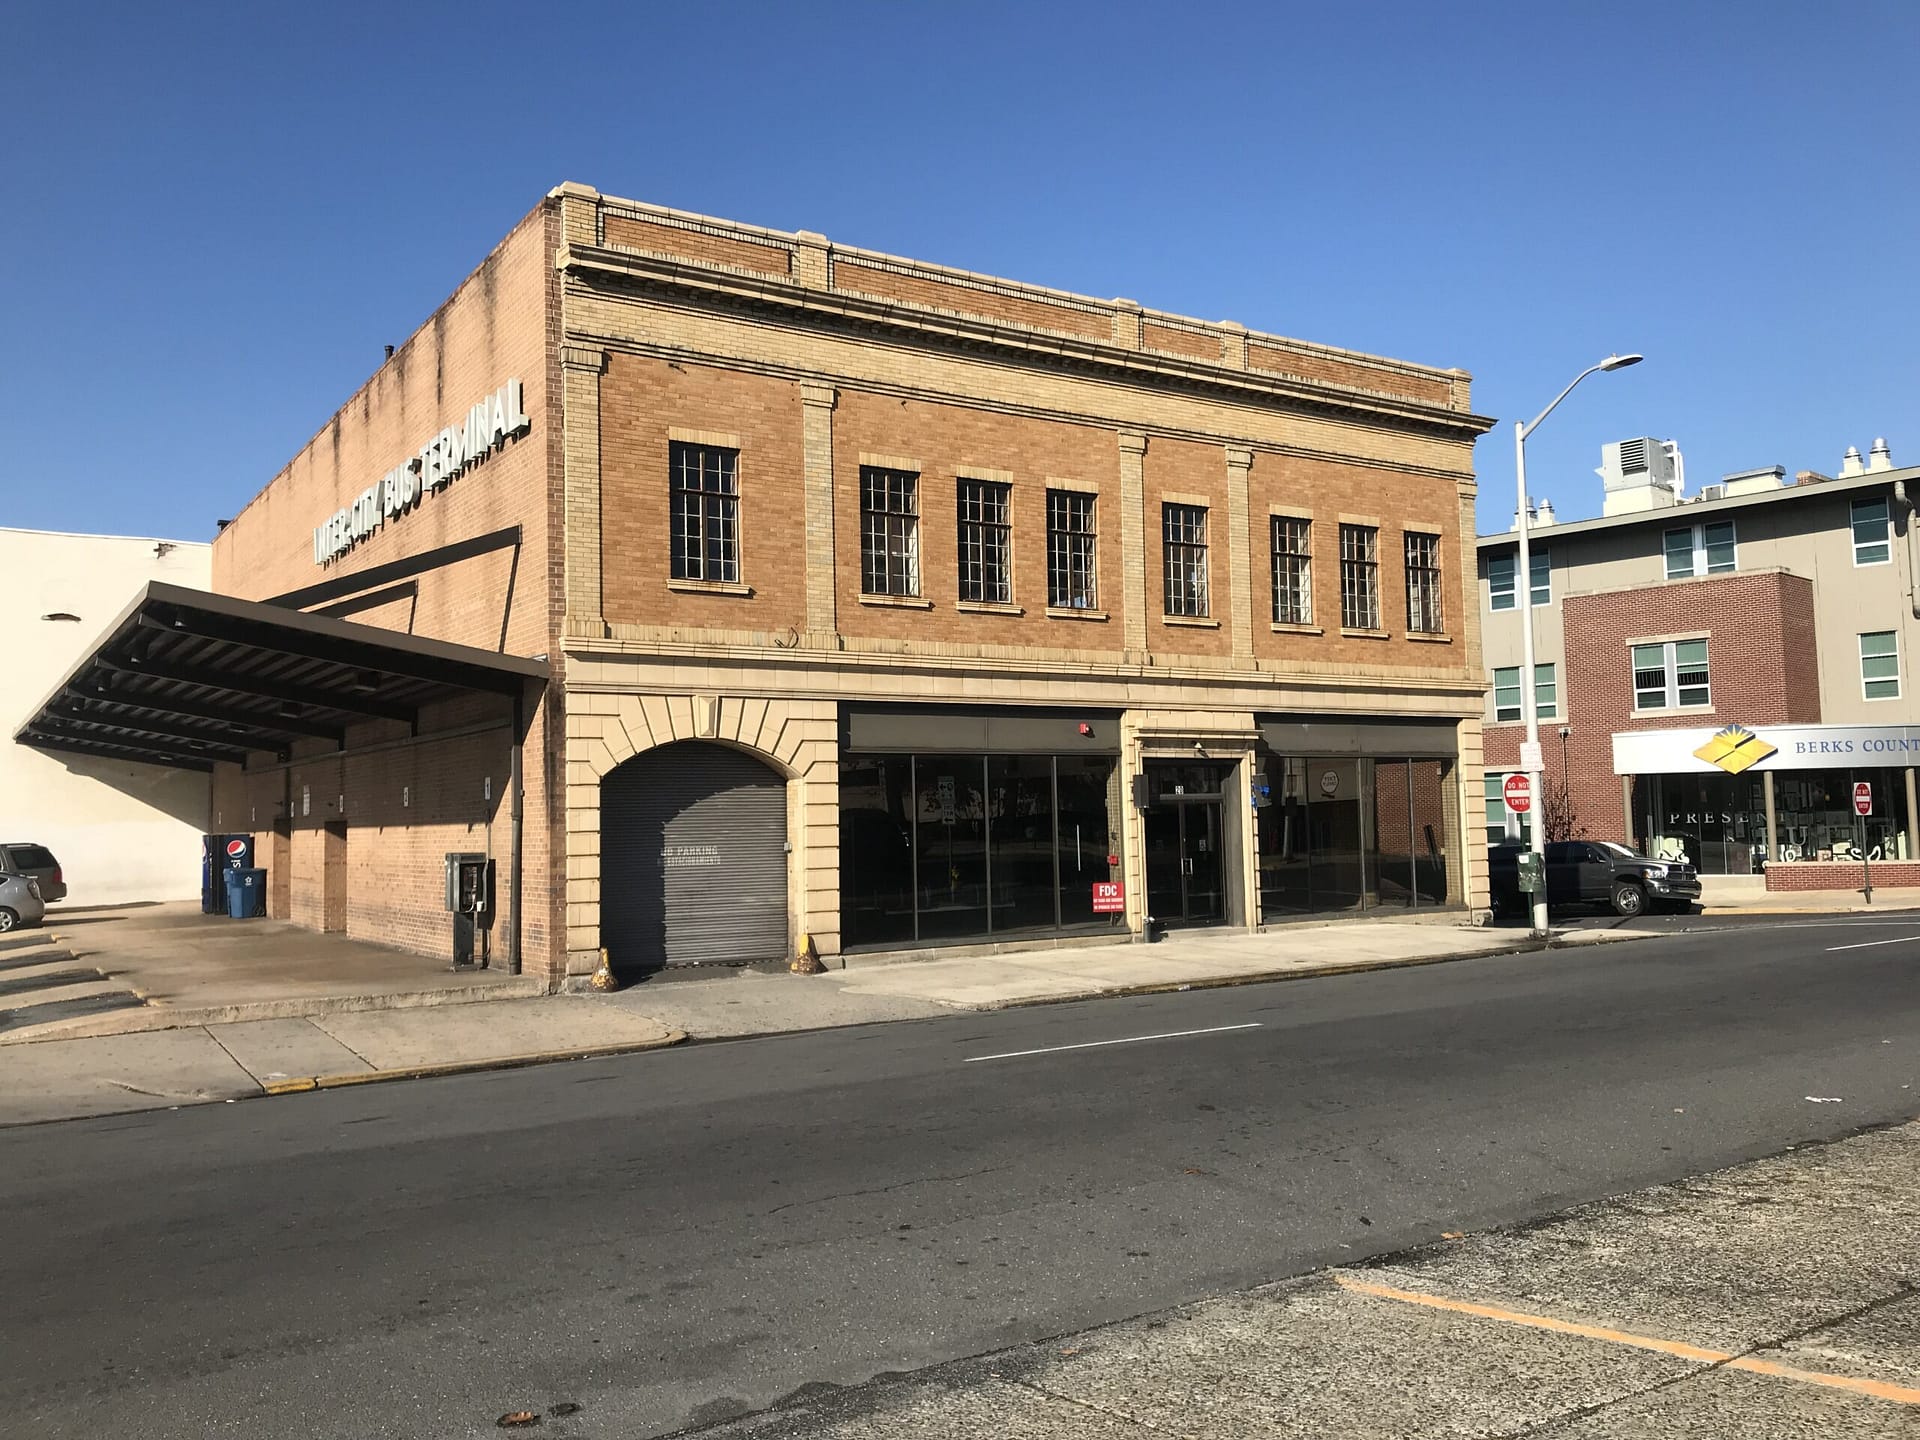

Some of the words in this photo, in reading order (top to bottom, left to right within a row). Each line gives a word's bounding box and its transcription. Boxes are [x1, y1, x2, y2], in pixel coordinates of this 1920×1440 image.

[384, 457, 420, 518] BUS
[419, 377, 529, 491] TERMINAL
[1795, 740, 1854, 754] BERKS
[1511, 798, 1529, 806] ENTER
[677, 845, 718, 856] PARKING
[1098, 884, 1118, 897] FDC
